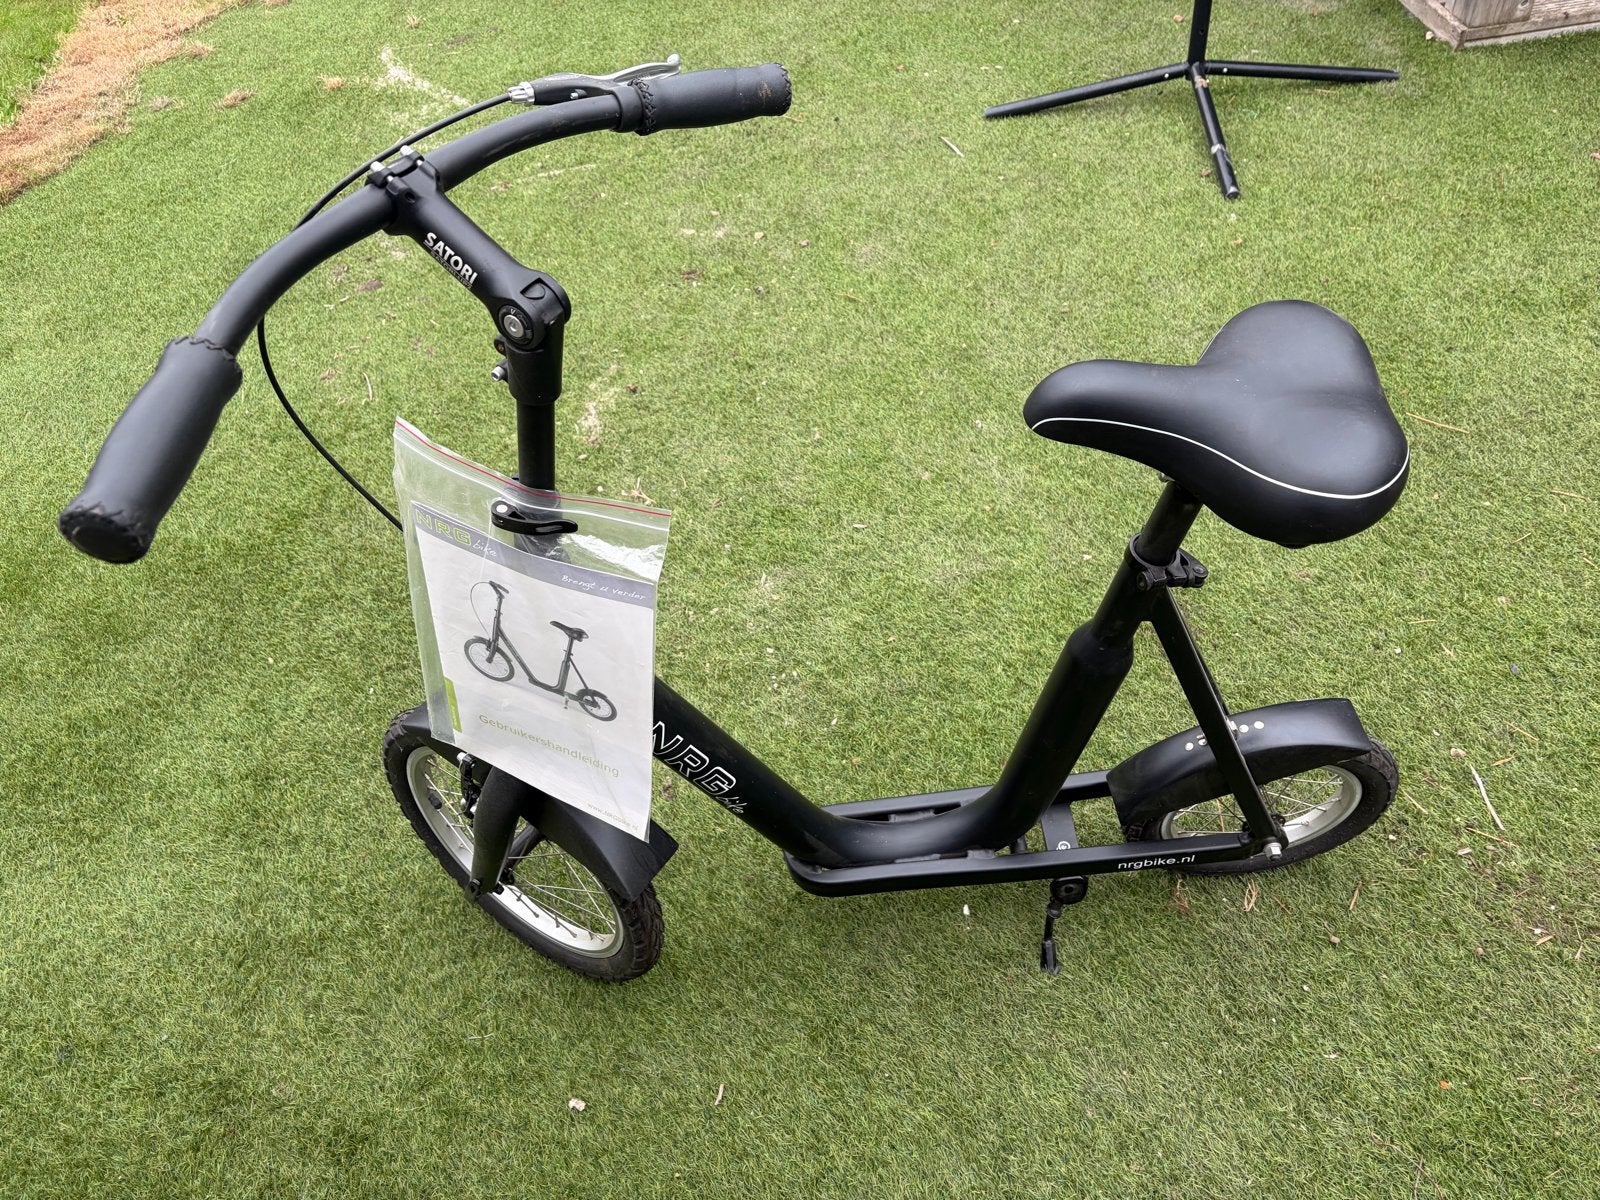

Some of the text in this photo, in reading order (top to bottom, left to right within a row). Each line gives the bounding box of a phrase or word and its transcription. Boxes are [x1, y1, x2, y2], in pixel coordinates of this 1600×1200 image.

[424, 231, 478, 285] SATORI
[415, 508, 497, 557] NRG bike
[561, 574, 596, 591] Brengt
[478, 713, 620, 778] Gebruikershandleiding
[652, 720, 737, 796] NRG
[1117, 854, 1197, 870] nrgbike.nl
